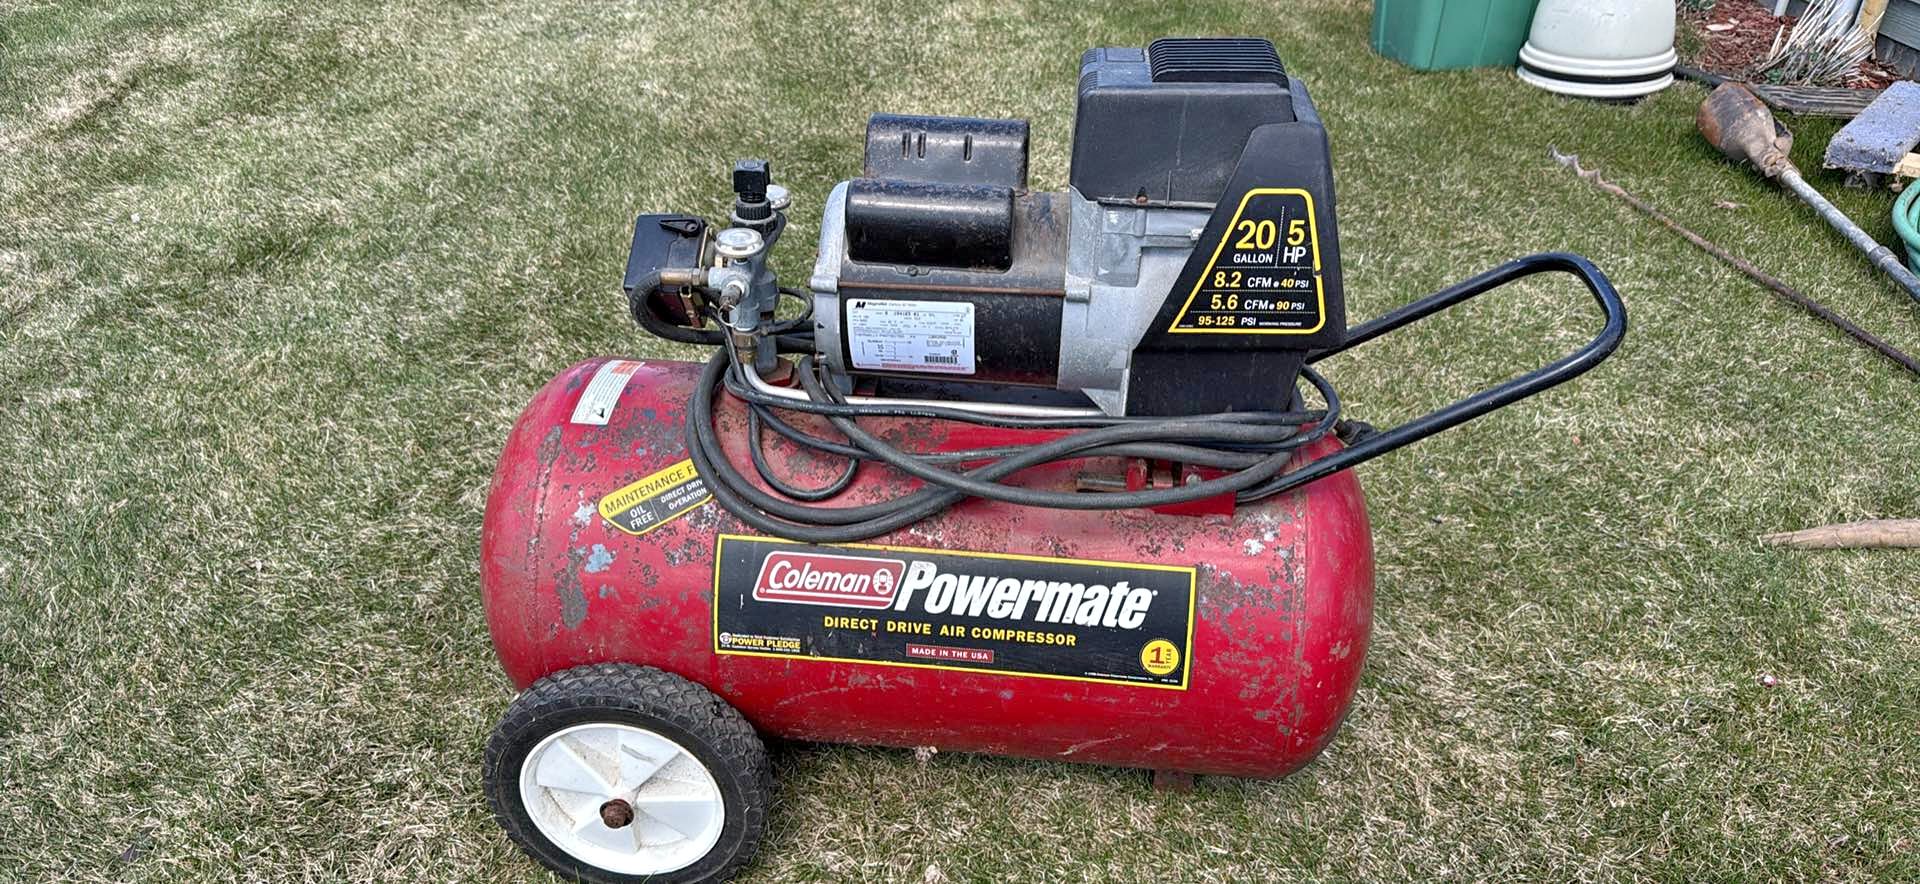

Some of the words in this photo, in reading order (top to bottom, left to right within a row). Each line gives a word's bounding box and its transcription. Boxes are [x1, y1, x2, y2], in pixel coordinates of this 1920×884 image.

[1235, 219, 1277, 250] 20
[1287, 219, 1305, 246] 5
[1233, 253, 1273, 264] GALLON
[1282, 246, 1307, 264] HP
[1214, 271, 1242, 288] 8.2
[1247, 277, 1272, 288] CFM
[1280, 278, 1294, 288] 40
[1294, 279, 1309, 288] PSI
[1210, 294, 1239, 310] 5.6
[1244, 299, 1269, 310] CFM
[1276, 301, 1290, 310] 90
[1290, 302, 1305, 310] PSI
[1198, 315, 1235, 326] 95-125
[1240, 317, 1257, 326] PSI
[605, 470, 685, 514] MAINTENANCE
[660, 486, 685, 504] DIRECT
[686, 478, 703, 491] DRIV
[668, 487, 707, 510] OPERATION
[629, 505, 647, 518] OIL
[630, 511, 655, 530] FREE
[769, 560, 871, 594] Coleman
[894, 560, 1153, 630] Powermate
[824, 615, 879, 631] DIRECT
[886, 621, 932, 635] DRIVE
[939, 623, 966, 638] AIR
[971, 626, 1077, 647] COMPRESSOR
[732, 637, 764, 647] POWER
[766, 639, 801, 649] PLEDGE
[911, 647, 937, 656] MADE
[951, 649, 968, 658] THE
[970, 651, 989, 660] USA
[1149, 646, 1165, 664] 1
